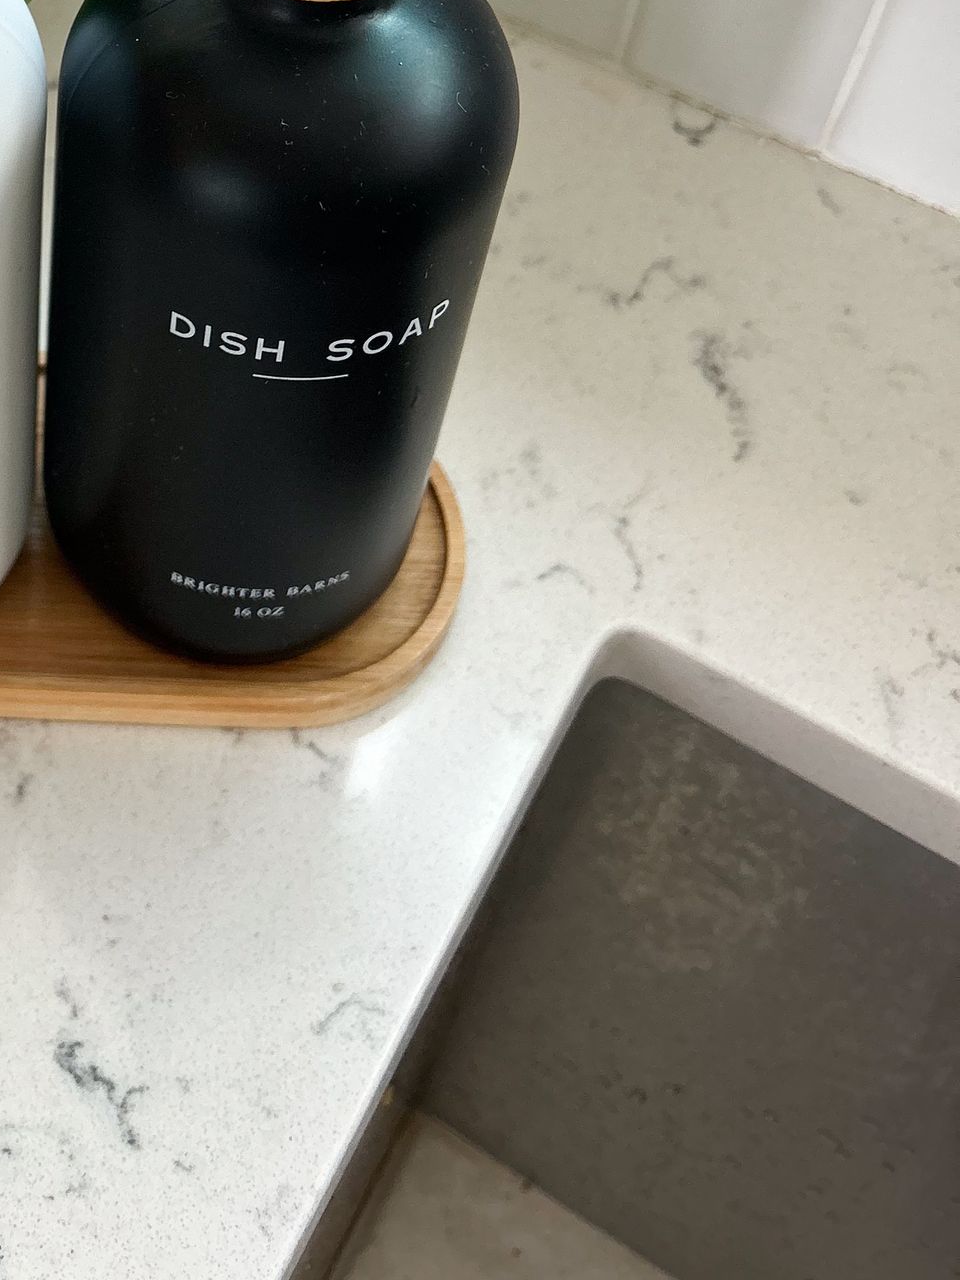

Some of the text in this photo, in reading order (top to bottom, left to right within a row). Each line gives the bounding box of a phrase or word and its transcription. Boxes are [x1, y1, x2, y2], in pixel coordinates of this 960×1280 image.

[169, 299, 450, 363] DISH SOAP
[170, 570, 350, 599] BRIGHTER BARNS
[233, 606, 285, 619] 16 OZ
